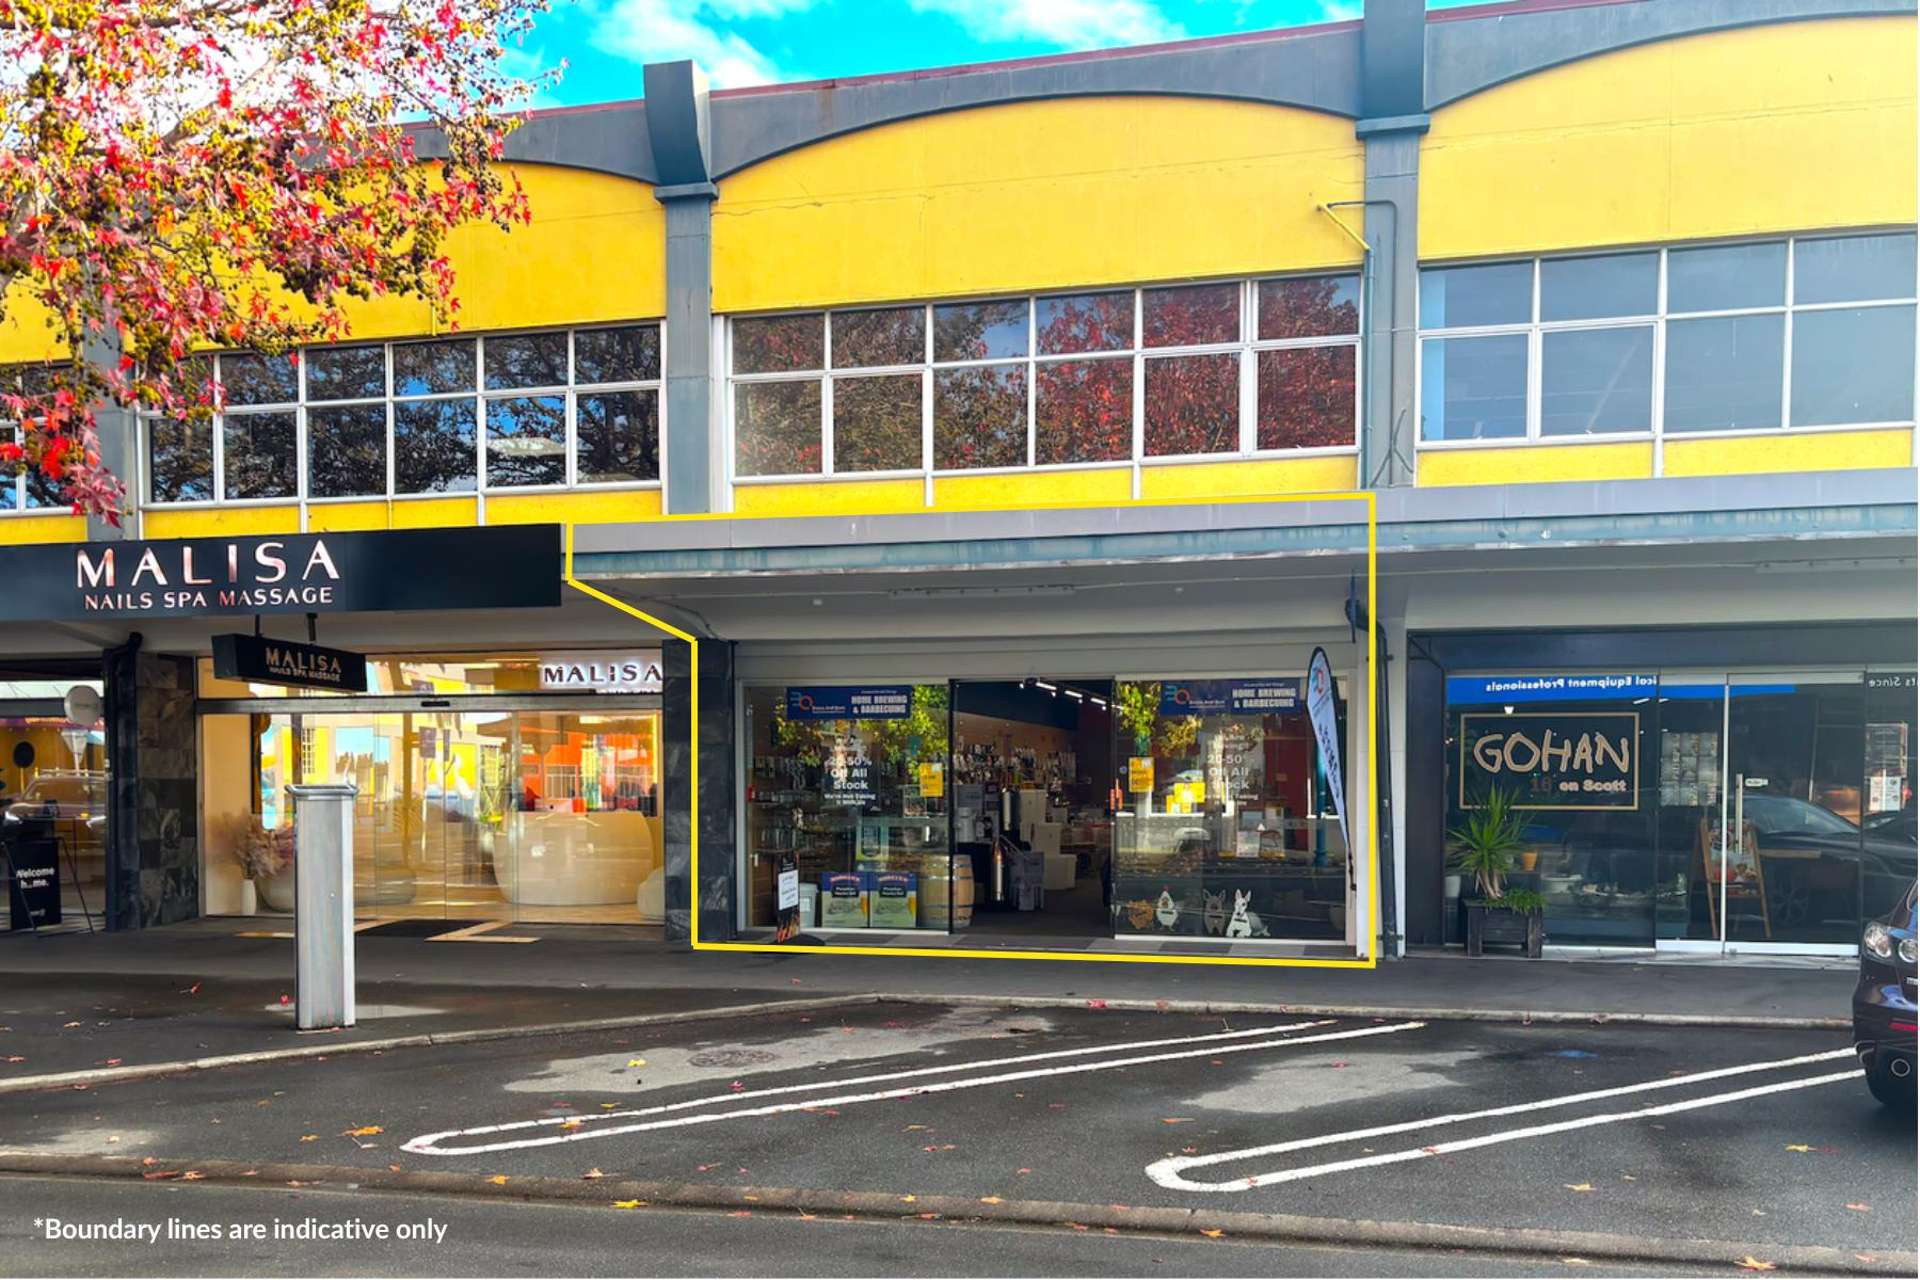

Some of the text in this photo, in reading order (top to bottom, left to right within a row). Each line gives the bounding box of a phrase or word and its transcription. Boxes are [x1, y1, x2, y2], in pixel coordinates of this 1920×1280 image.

[77, 539, 340, 588] MALISA
[84, 586, 333, 611] NAILS SPA MASSAGE
[265, 646, 342, 674] MALISA
[545, 664, 663, 682] MALISA
[1473, 728, 1630, 774] GOHAN
[851, 768, 868, 778] All
[1231, 767, 1249, 777] All
[833, 780, 869, 790] Stock
[1559, 780, 1580, 792] on
[1582, 779, 1628, 792] Scott
[16, 868, 55, 878] Welcome
